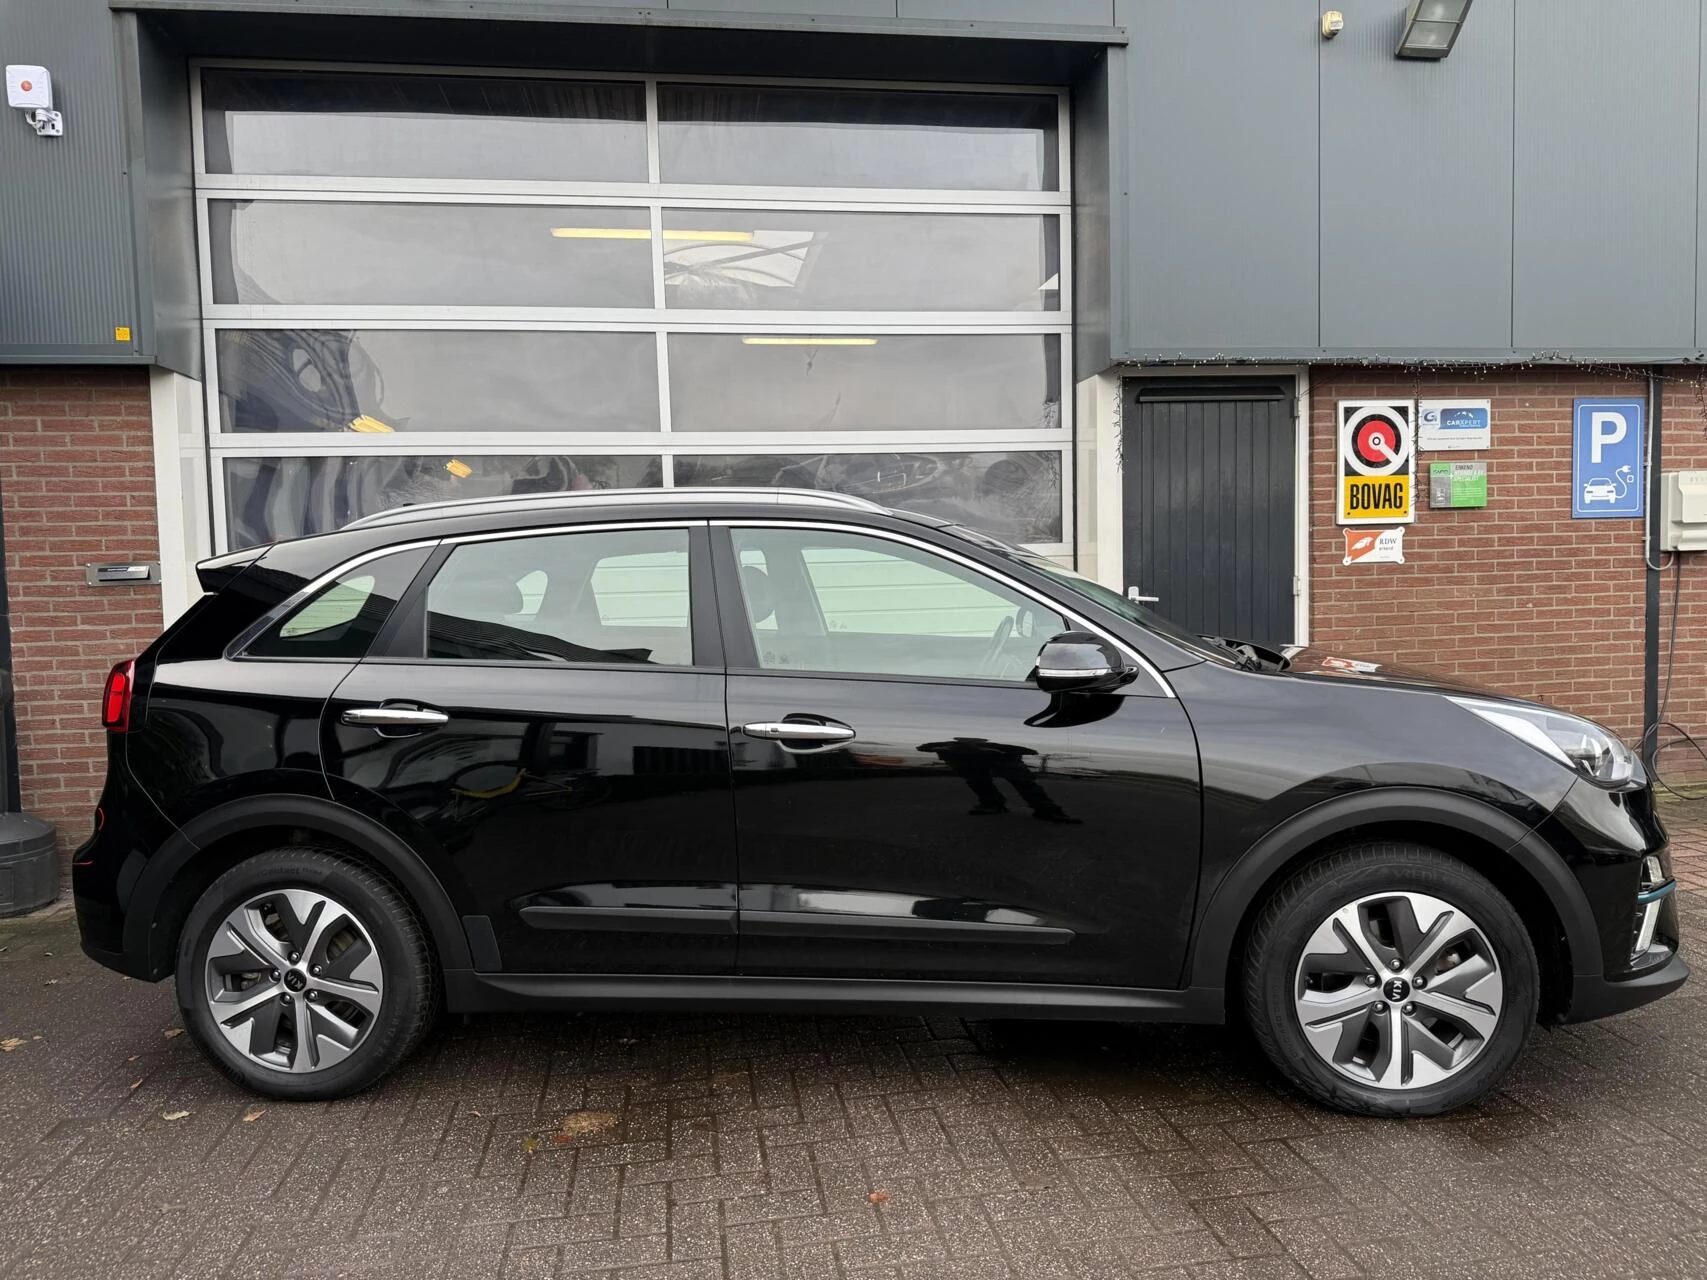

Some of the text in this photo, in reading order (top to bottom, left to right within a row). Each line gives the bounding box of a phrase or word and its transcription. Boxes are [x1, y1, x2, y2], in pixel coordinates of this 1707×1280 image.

[1591, 411, 1627, 463] P
[1350, 482, 1403, 510] BOVAG
[287, 972, 303, 990] KIA
[1391, 980, 1402, 1000] KIA
